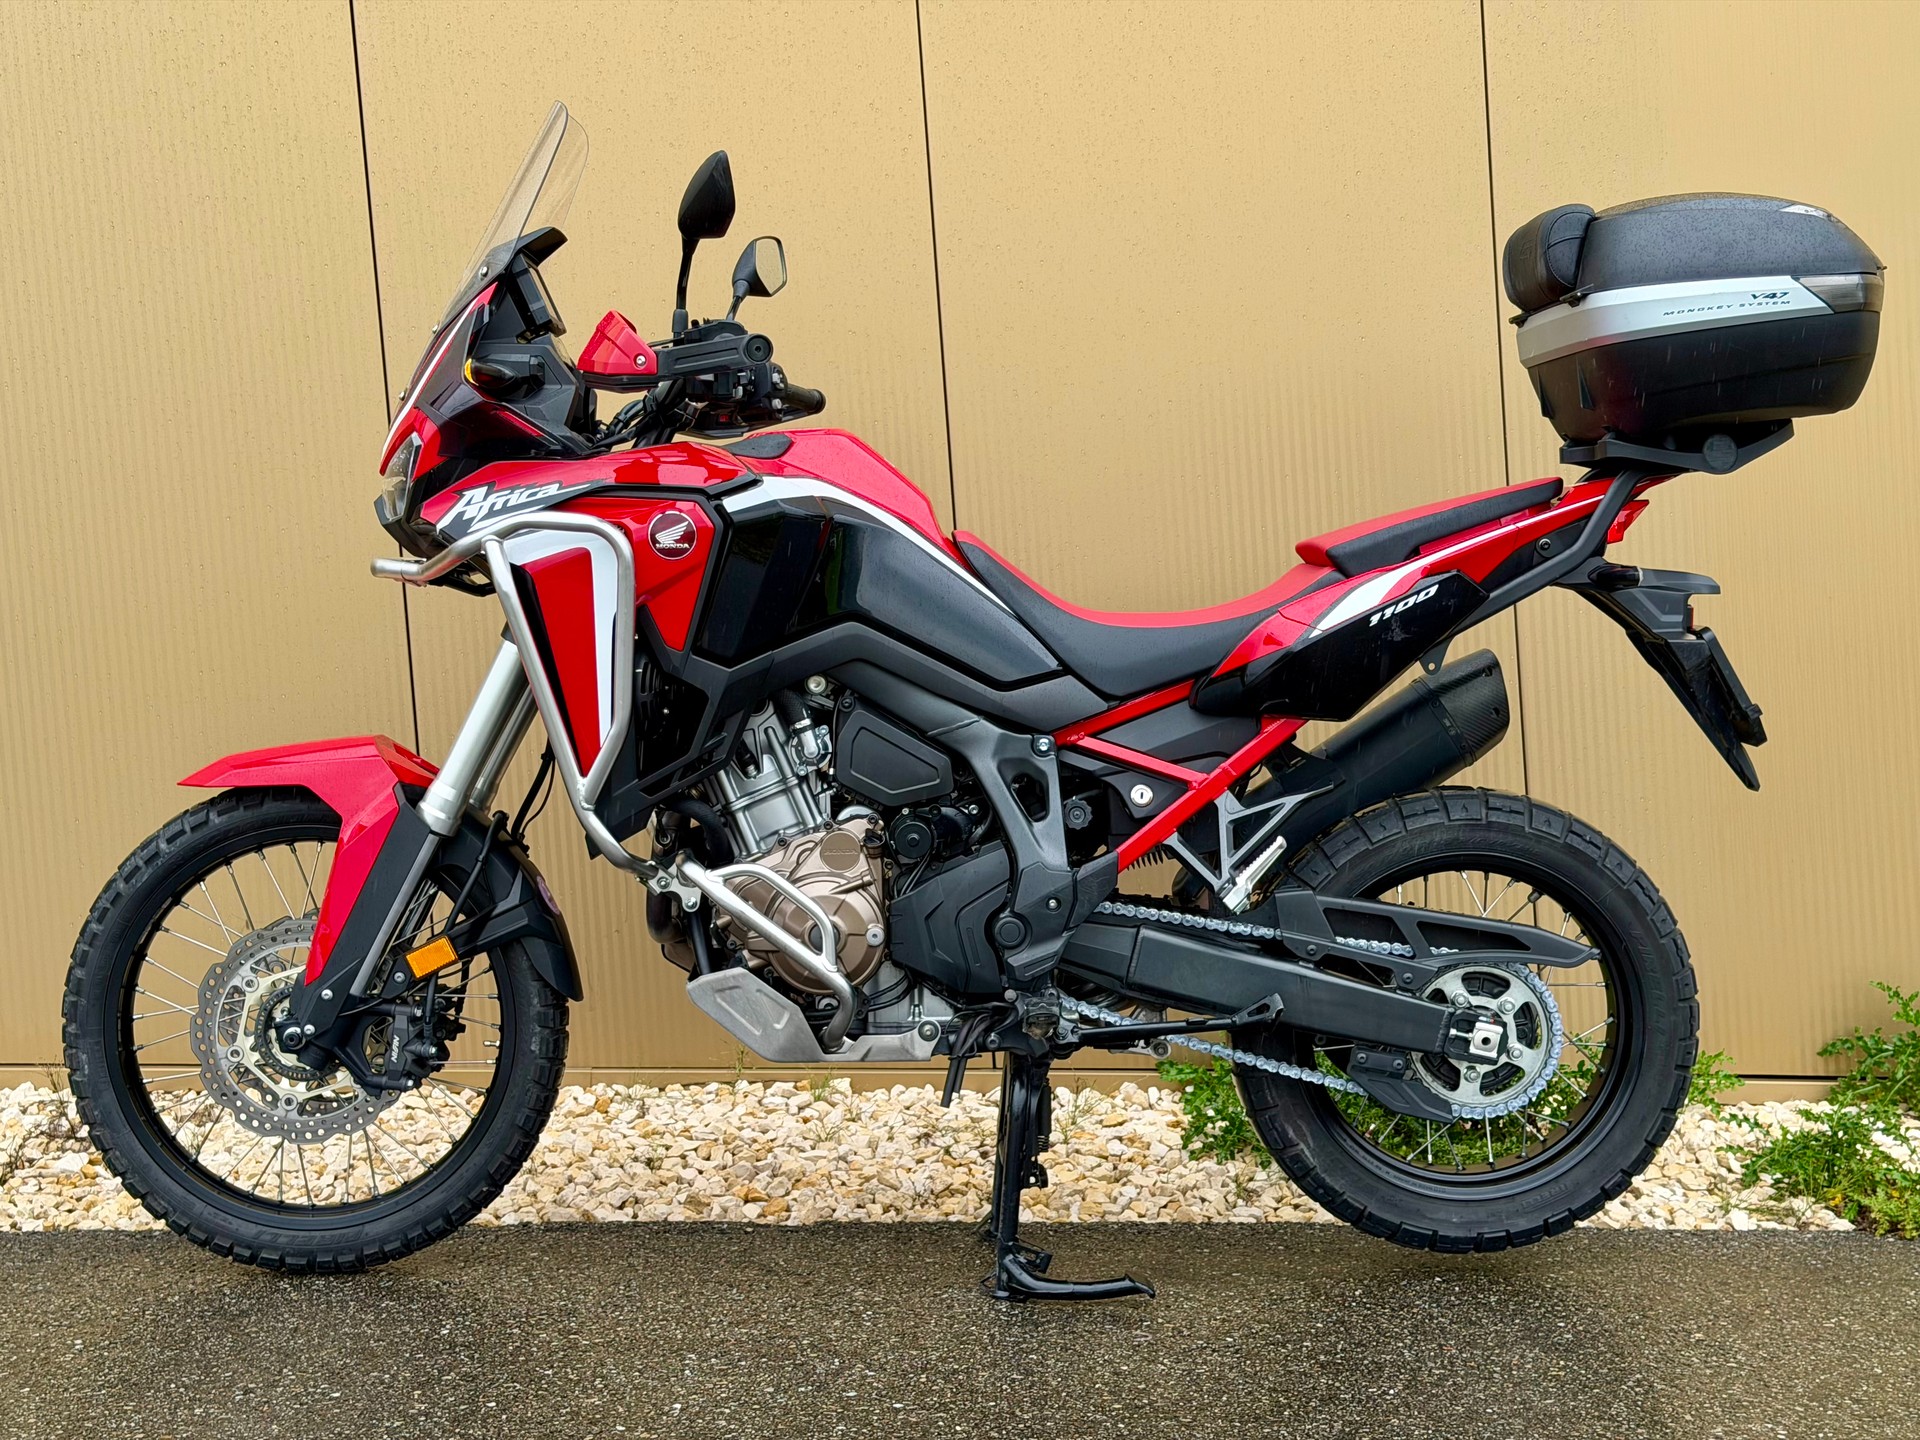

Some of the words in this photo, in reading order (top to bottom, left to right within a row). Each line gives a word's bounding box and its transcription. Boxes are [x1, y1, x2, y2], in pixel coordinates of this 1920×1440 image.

[1663, 303, 1734, 316] MONOKEY
[1739, 300, 1791, 308] SYSTEM
[1750, 291, 1790, 301] V47
[436, 483, 588, 535] Africa
[1369, 584, 1439, 627] 1100
